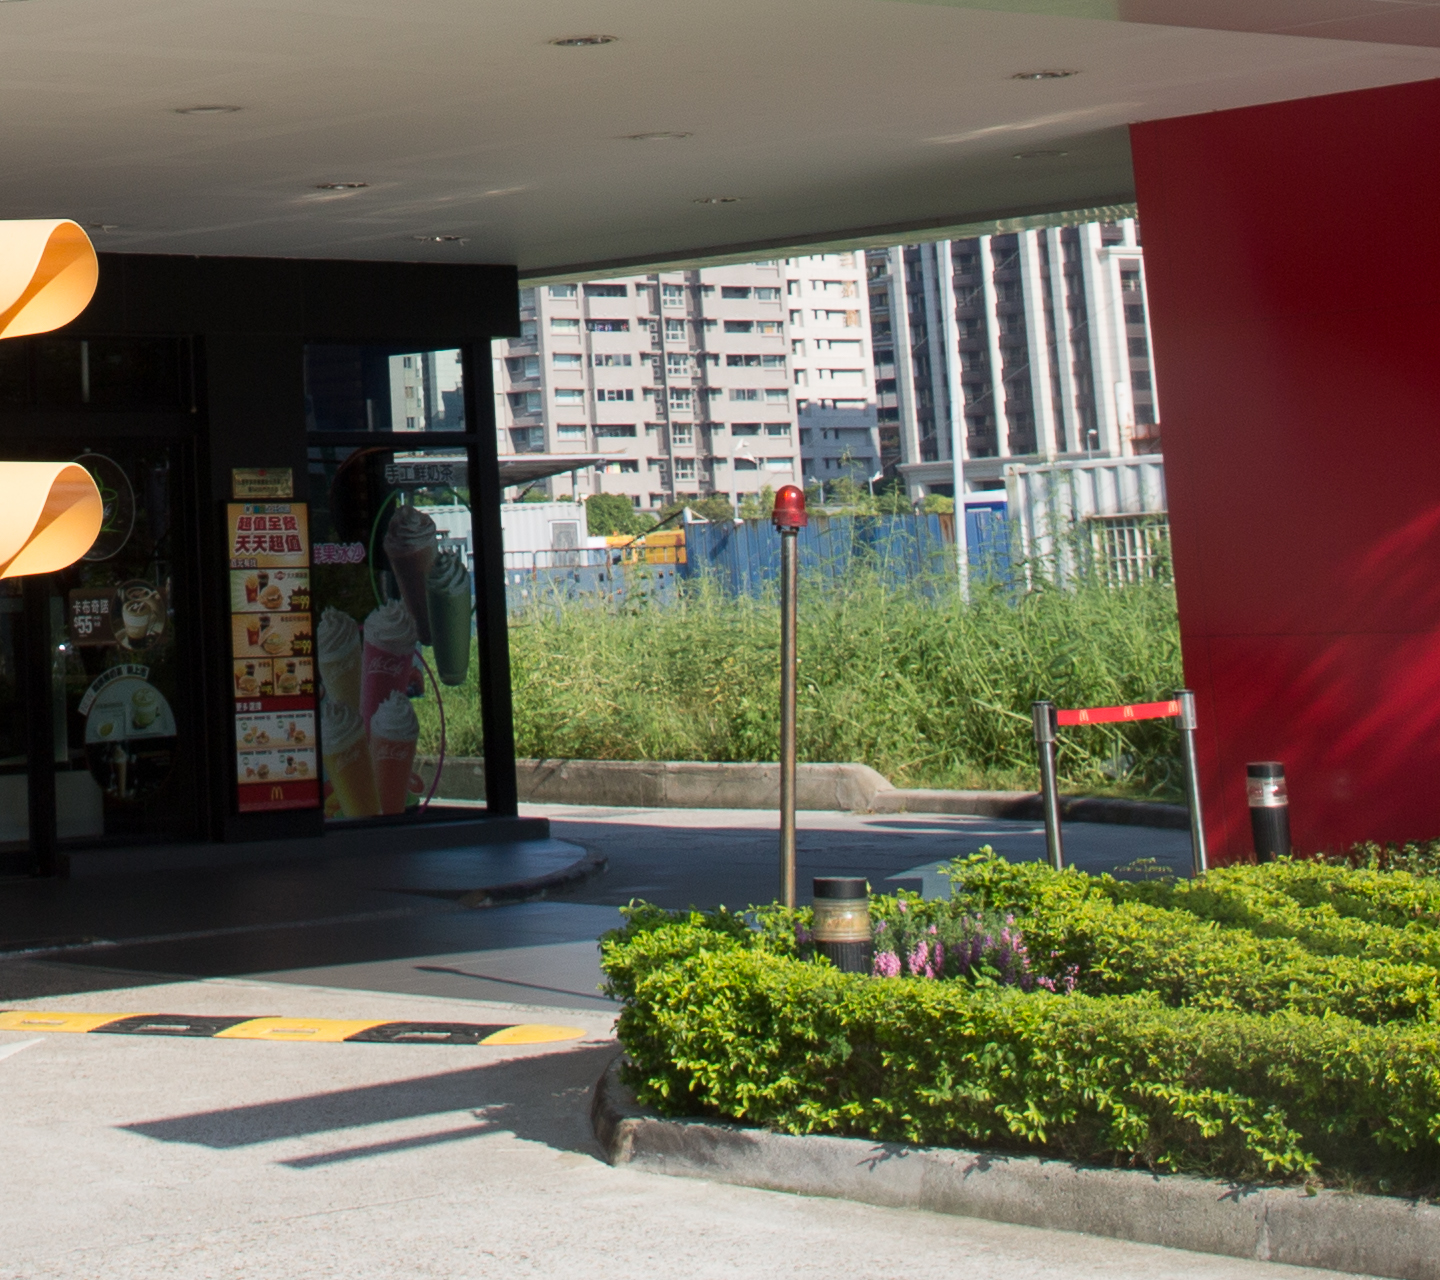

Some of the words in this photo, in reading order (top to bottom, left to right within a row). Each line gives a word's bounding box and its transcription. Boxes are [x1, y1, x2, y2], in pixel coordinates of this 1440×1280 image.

[385, 463, 454, 483] 手工鮮奶茶
[236, 515, 298, 532] 超值全餐
[234, 534, 303, 554] 天天超值
